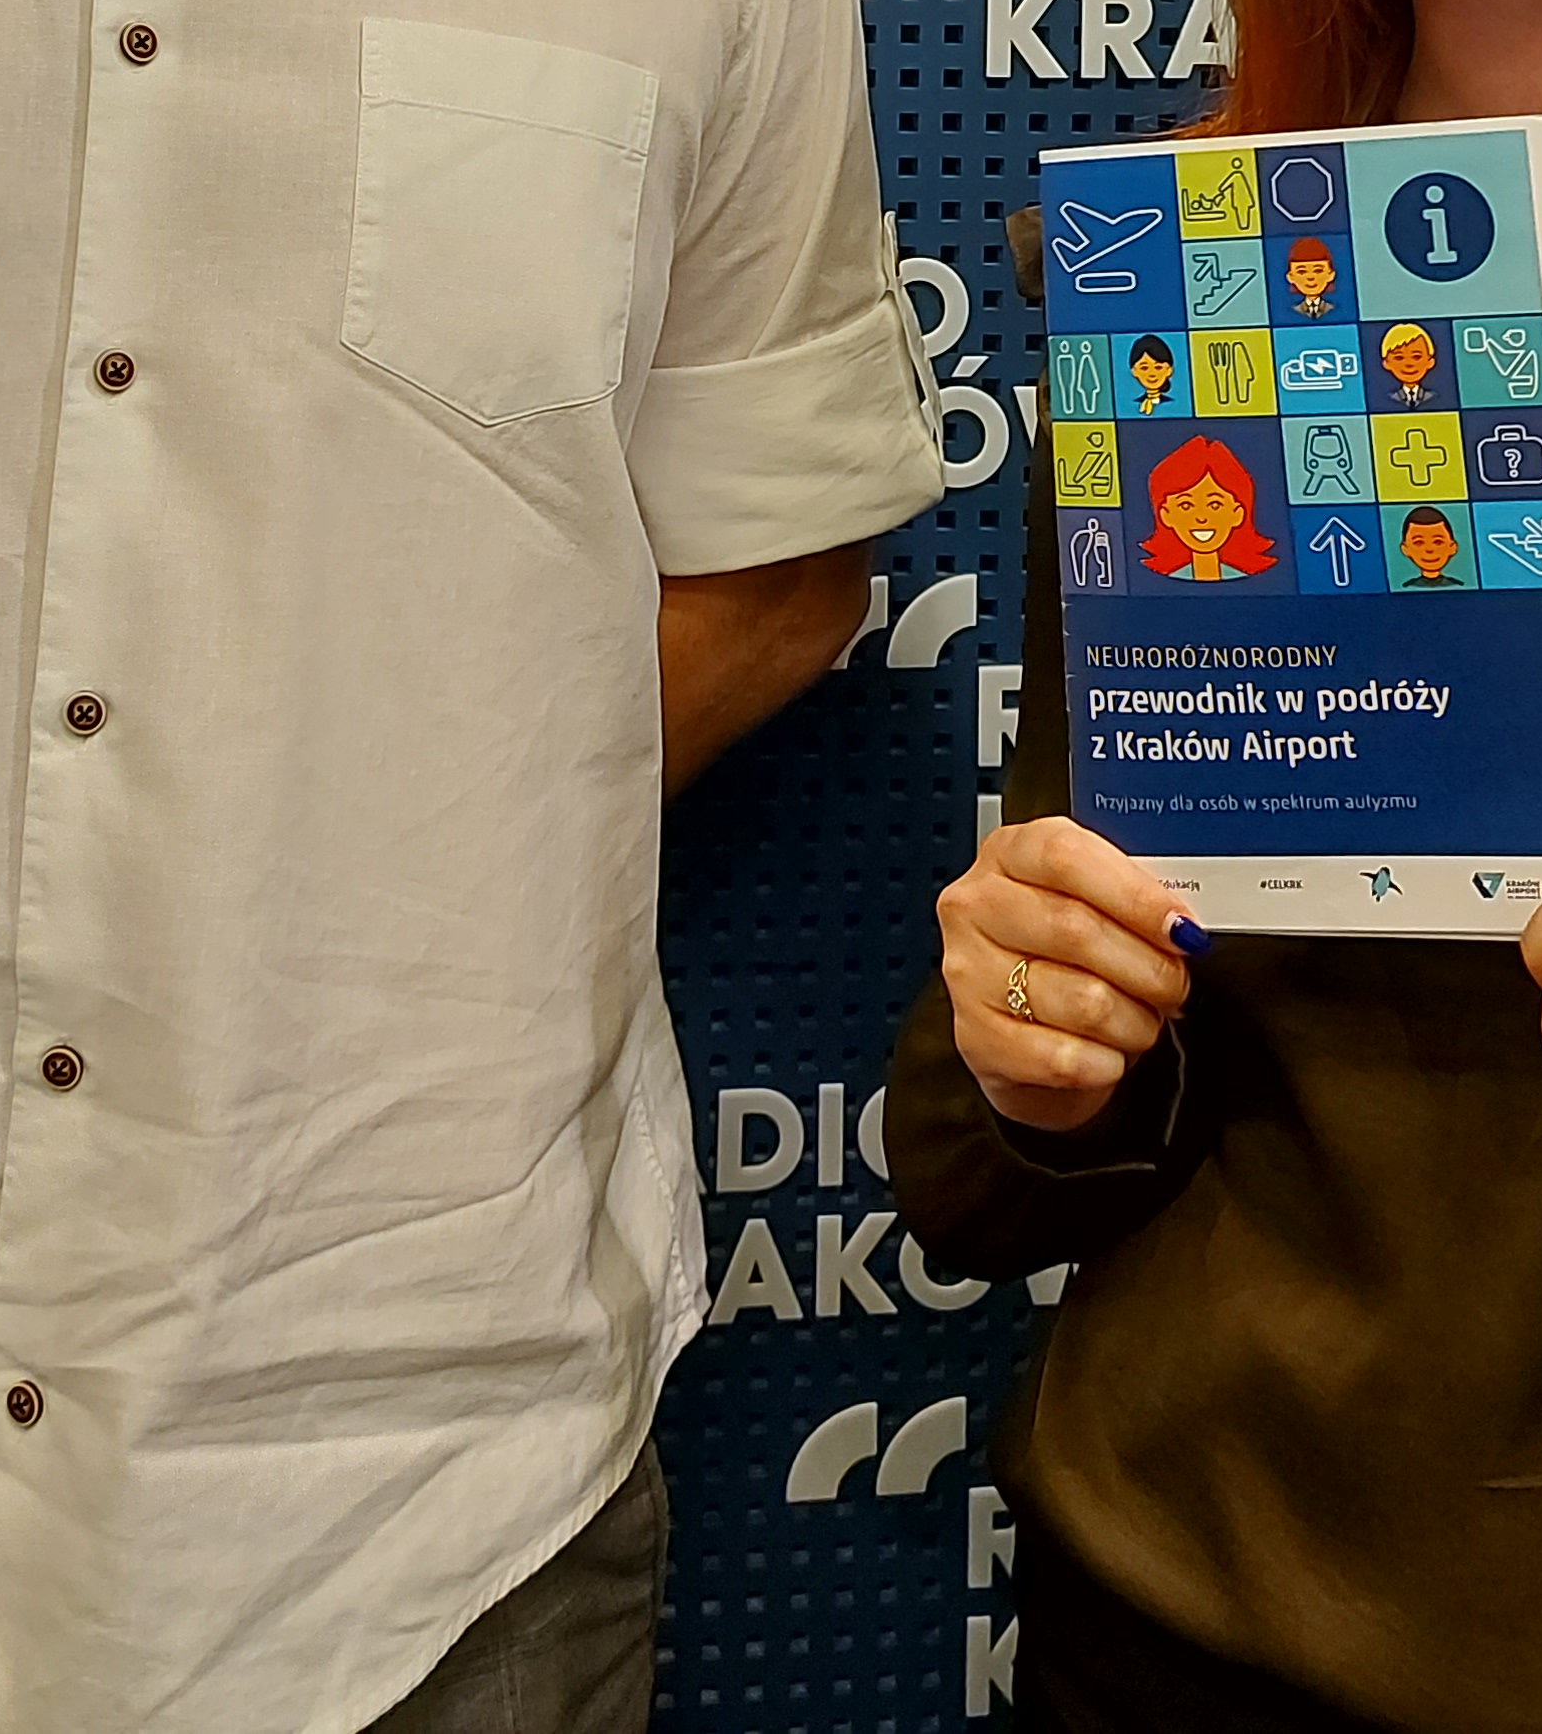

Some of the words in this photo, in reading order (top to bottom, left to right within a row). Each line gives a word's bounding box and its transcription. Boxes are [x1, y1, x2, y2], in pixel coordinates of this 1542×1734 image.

[1085, 643, 1337, 669] NEURORÓŻNORODNY
[1088, 681, 1268, 721] przewodnik
[1275, 688, 1305, 714] w
[1316, 678, 1451, 721] podróży
[1090, 734, 1108, 760] z
[1115, 728, 1231, 762] Kraków
[1242, 729, 1358, 769] Airport
[1094, 792, 1165, 815] Przyjazny
[1169, 793, 1194, 811] dla
[1199, 793, 1239, 811] osób
[1243, 797, 1257, 811] w
[1260, 793, 1340, 815] spektrum
[1344, 793, 1418, 813] autyzmu
